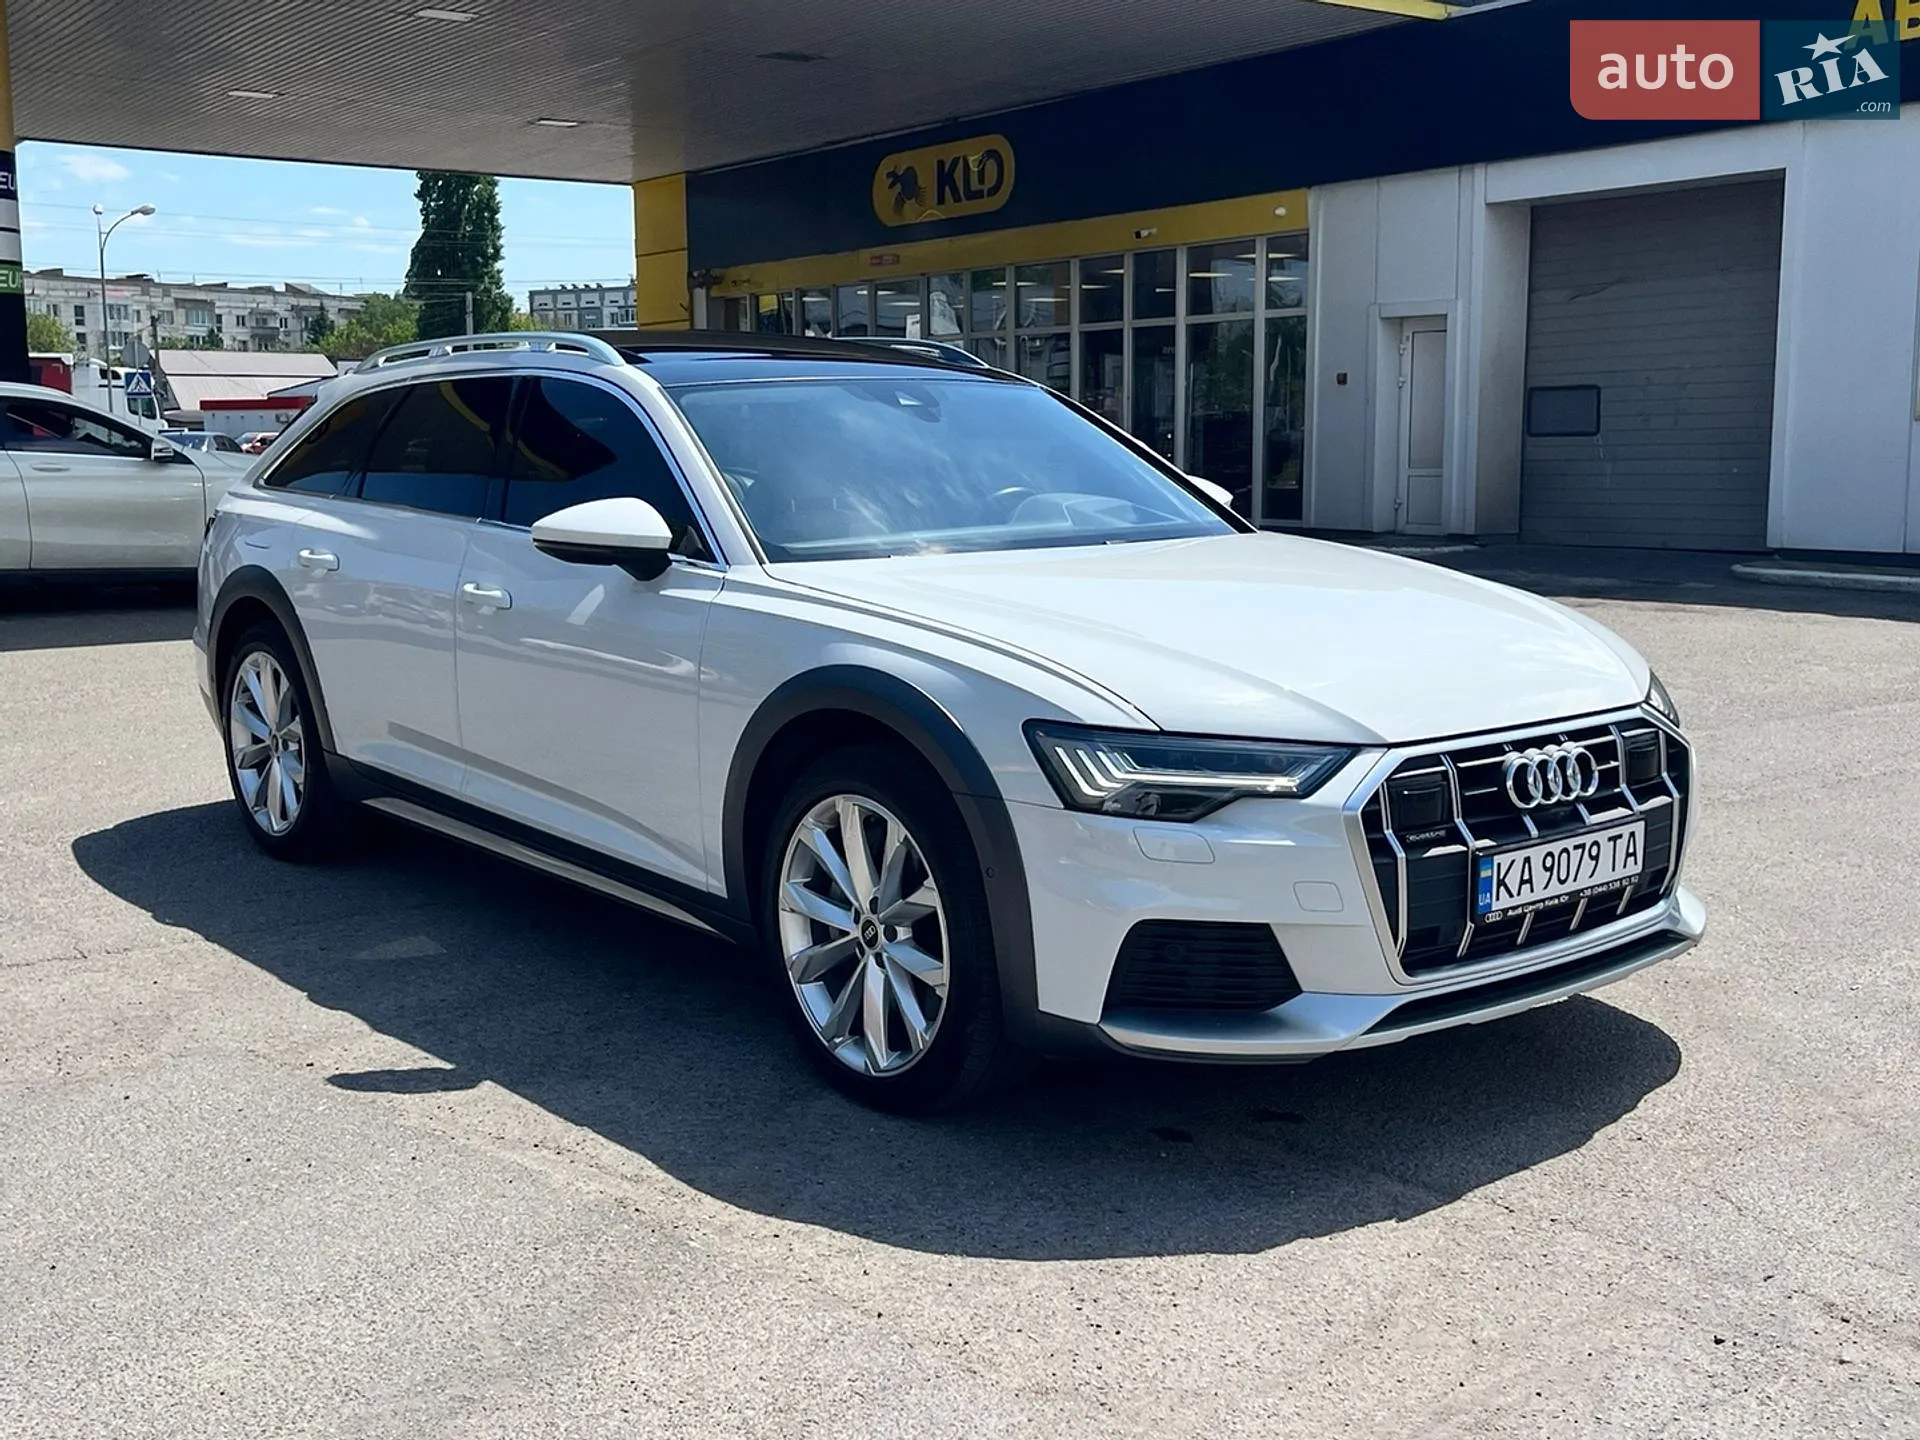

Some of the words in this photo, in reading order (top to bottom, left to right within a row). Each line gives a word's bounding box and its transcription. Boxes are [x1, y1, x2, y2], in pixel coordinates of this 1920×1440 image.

[1495, 856, 1535, 902] KA
[1542, 839, 1601, 891] 9079
[1607, 831, 1638, 872] TA
[1478, 892, 1491, 906] UA
